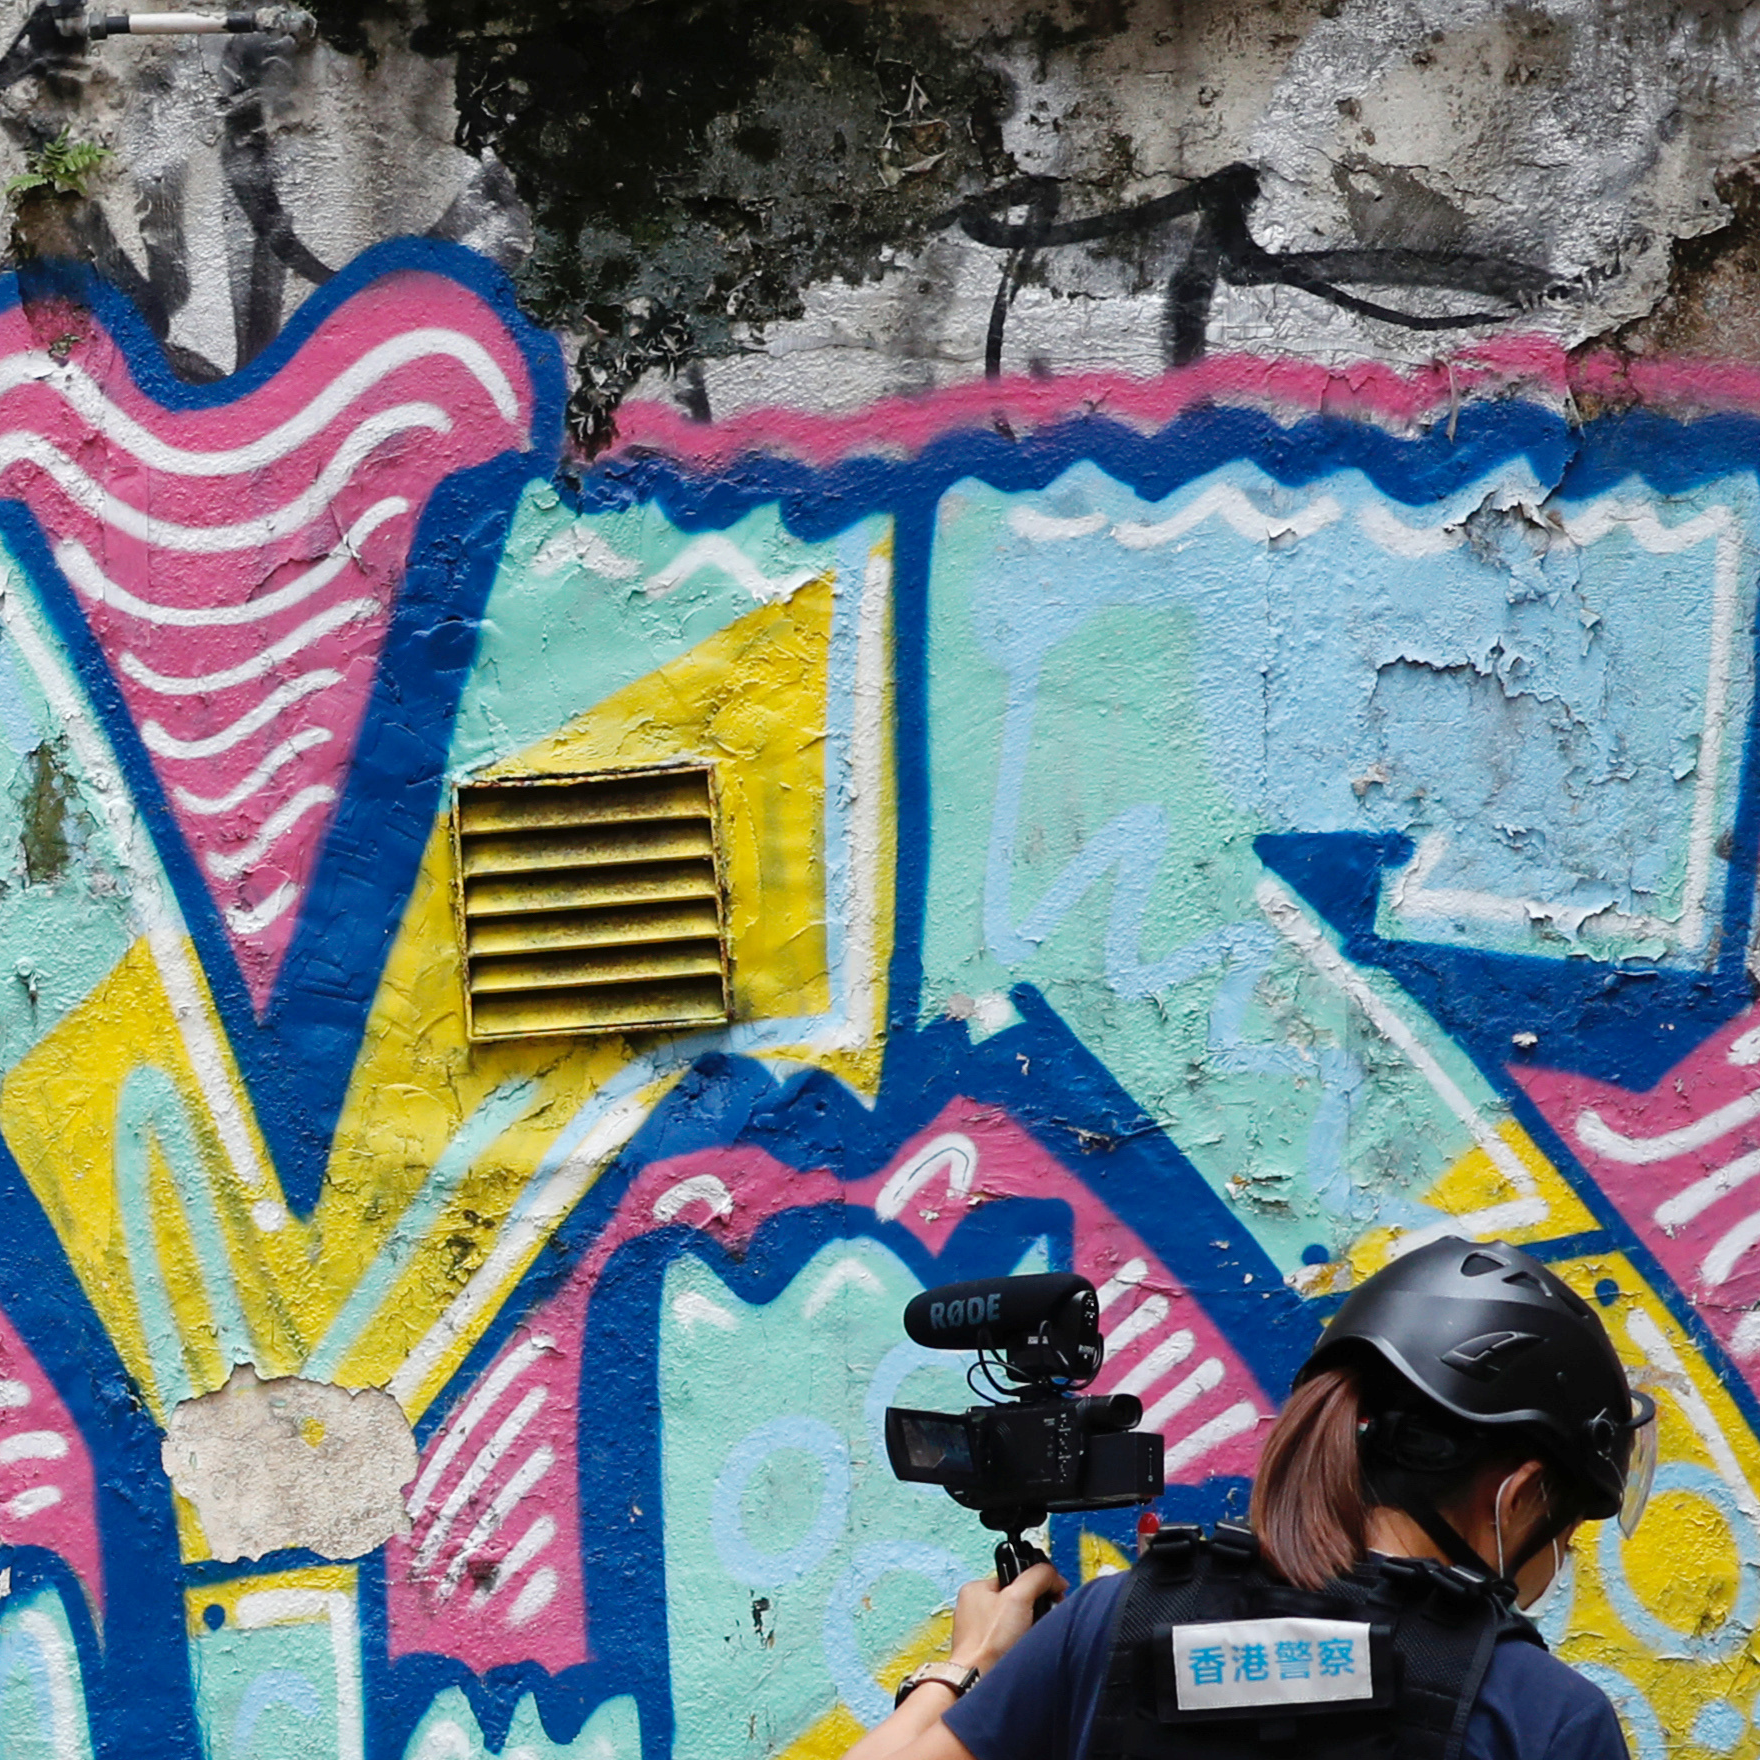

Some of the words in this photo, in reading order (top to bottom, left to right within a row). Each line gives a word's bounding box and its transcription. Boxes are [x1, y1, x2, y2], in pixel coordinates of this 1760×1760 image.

[930, 1293, 1002, 1330] RØDE
[1188, 1638, 1355, 1686] 香港警察
